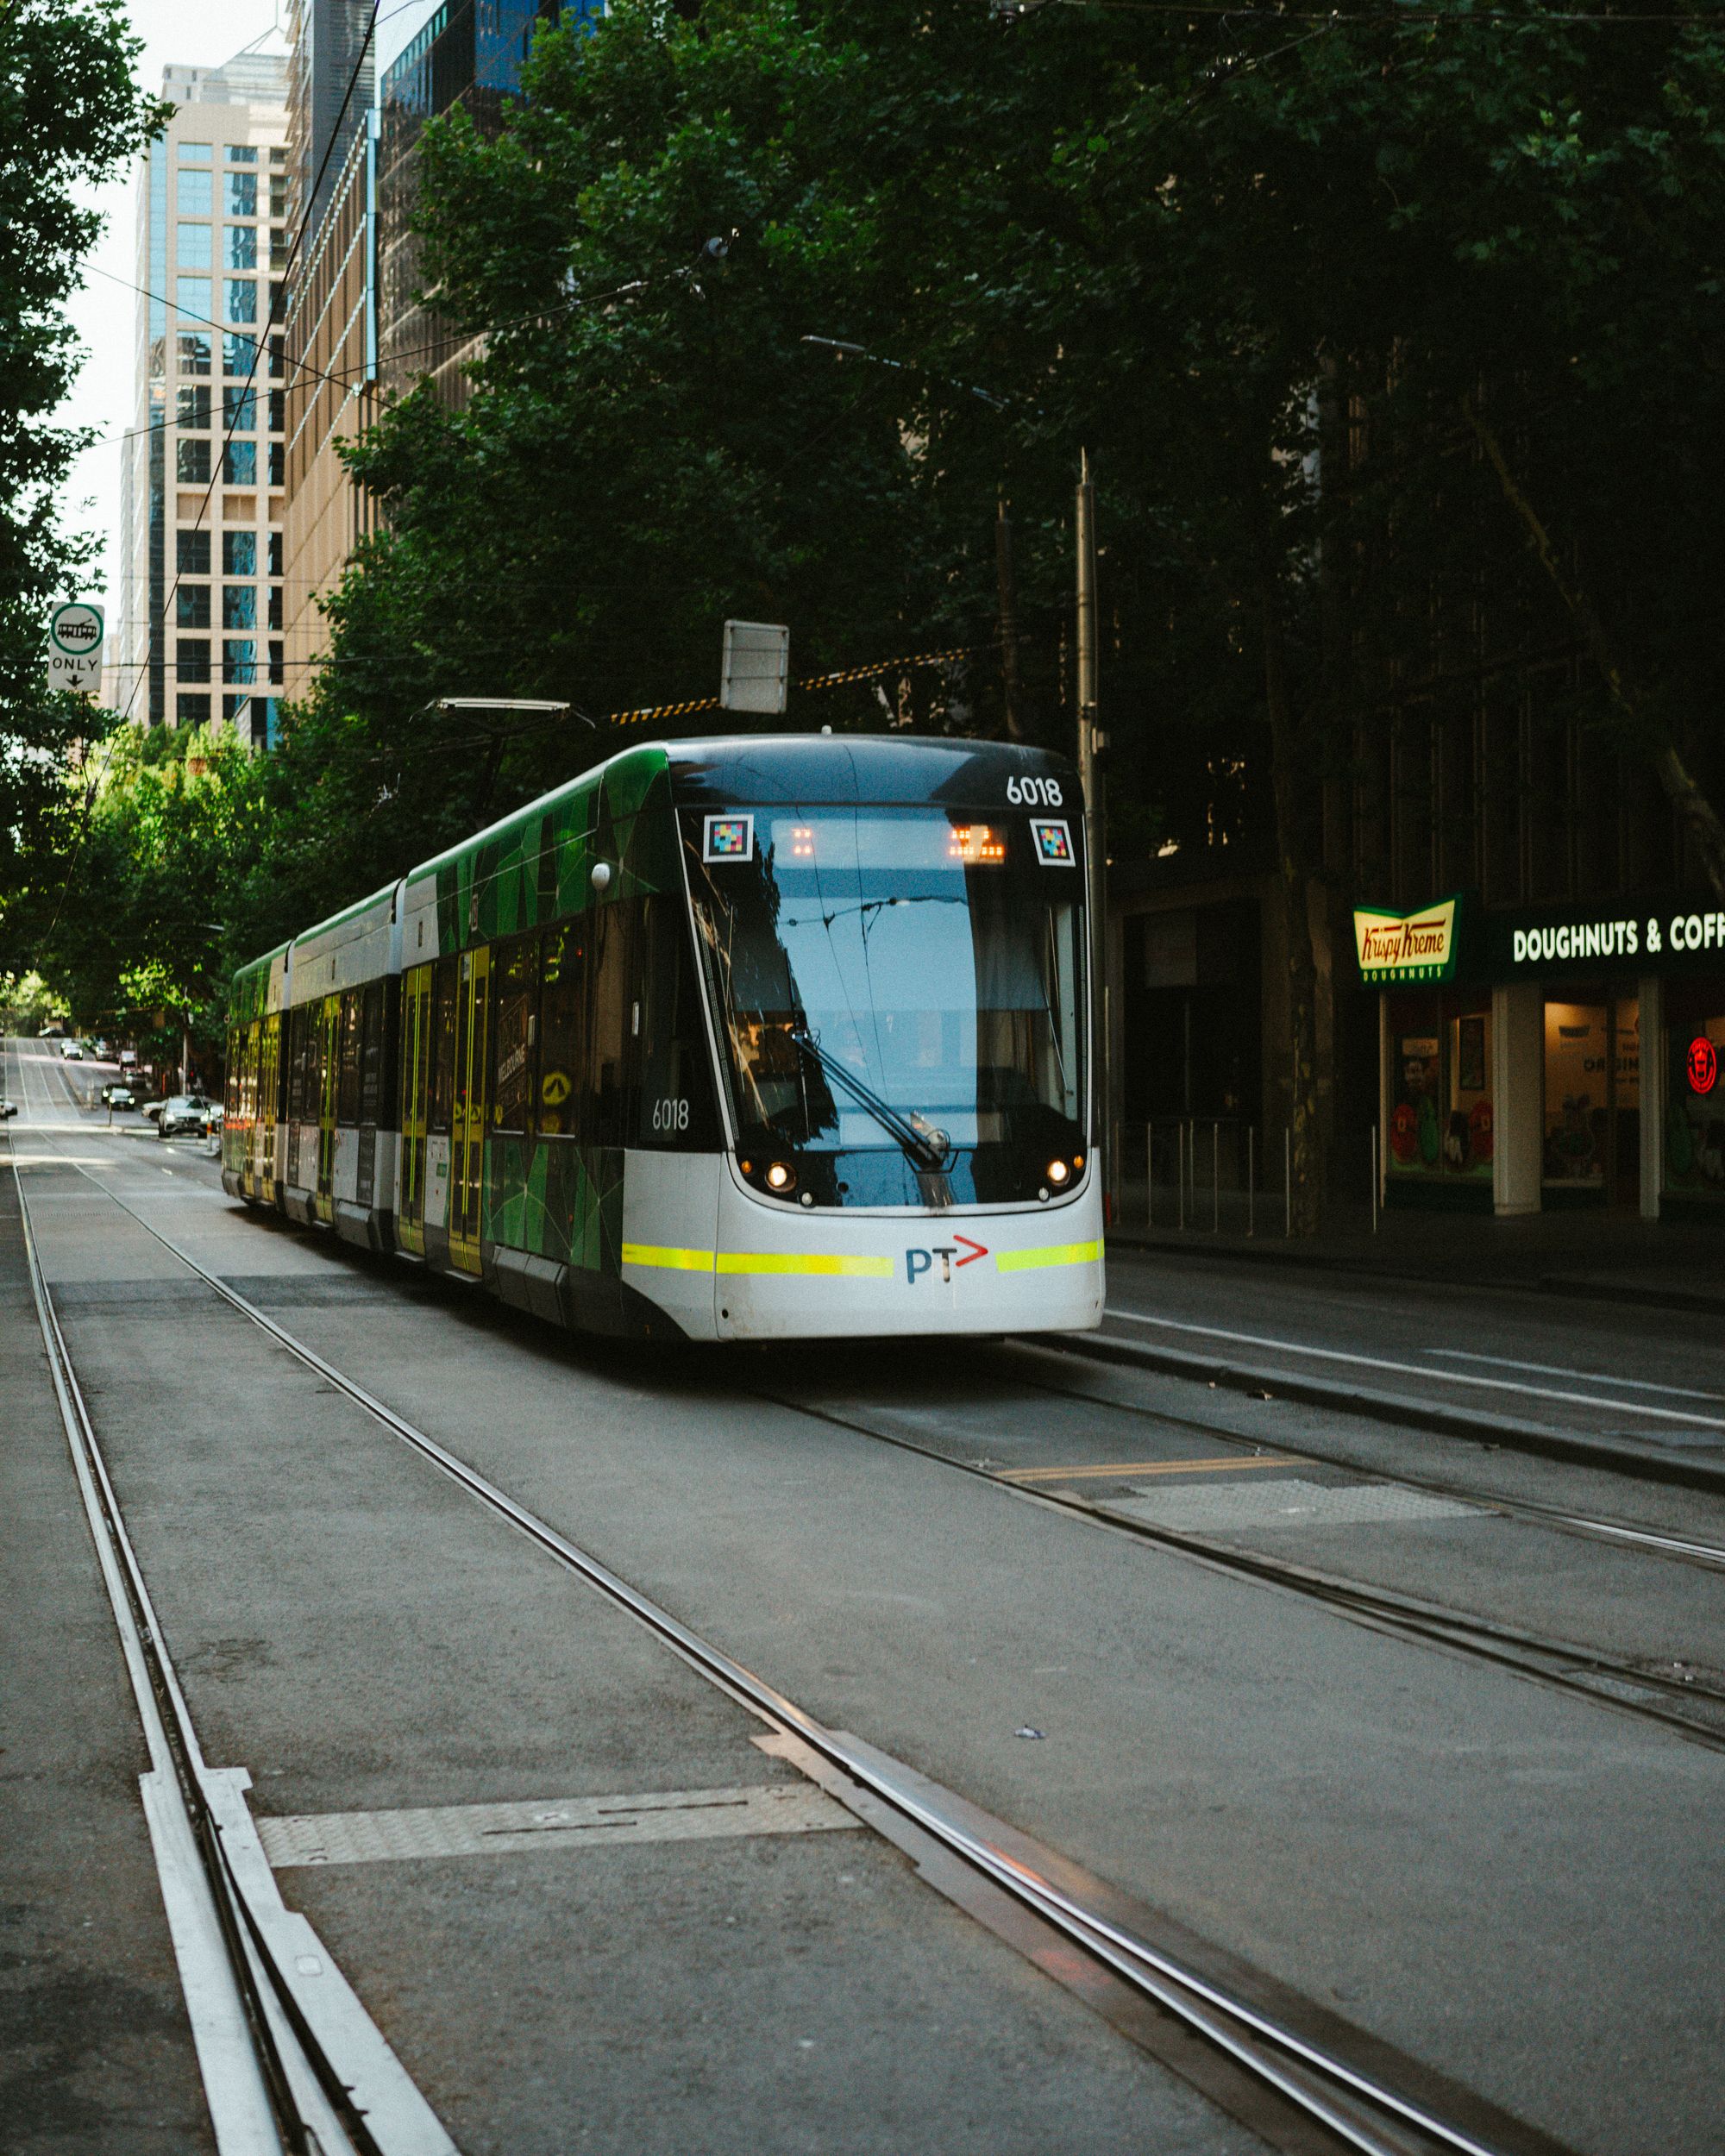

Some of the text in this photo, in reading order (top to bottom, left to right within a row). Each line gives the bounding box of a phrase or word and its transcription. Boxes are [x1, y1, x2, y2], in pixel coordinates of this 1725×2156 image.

[53, 657, 97, 671] ONLY
[1007, 776, 1063, 806] 6018
[1362, 918, 1446, 964] Krispy Kreme
[1514, 919, 1638, 962] DOUGHNUTS
[1647, 918, 1661, 953] &
[1363, 965, 1442, 982] DOUGHNUTS
[653, 1099, 689, 1130] 6018
